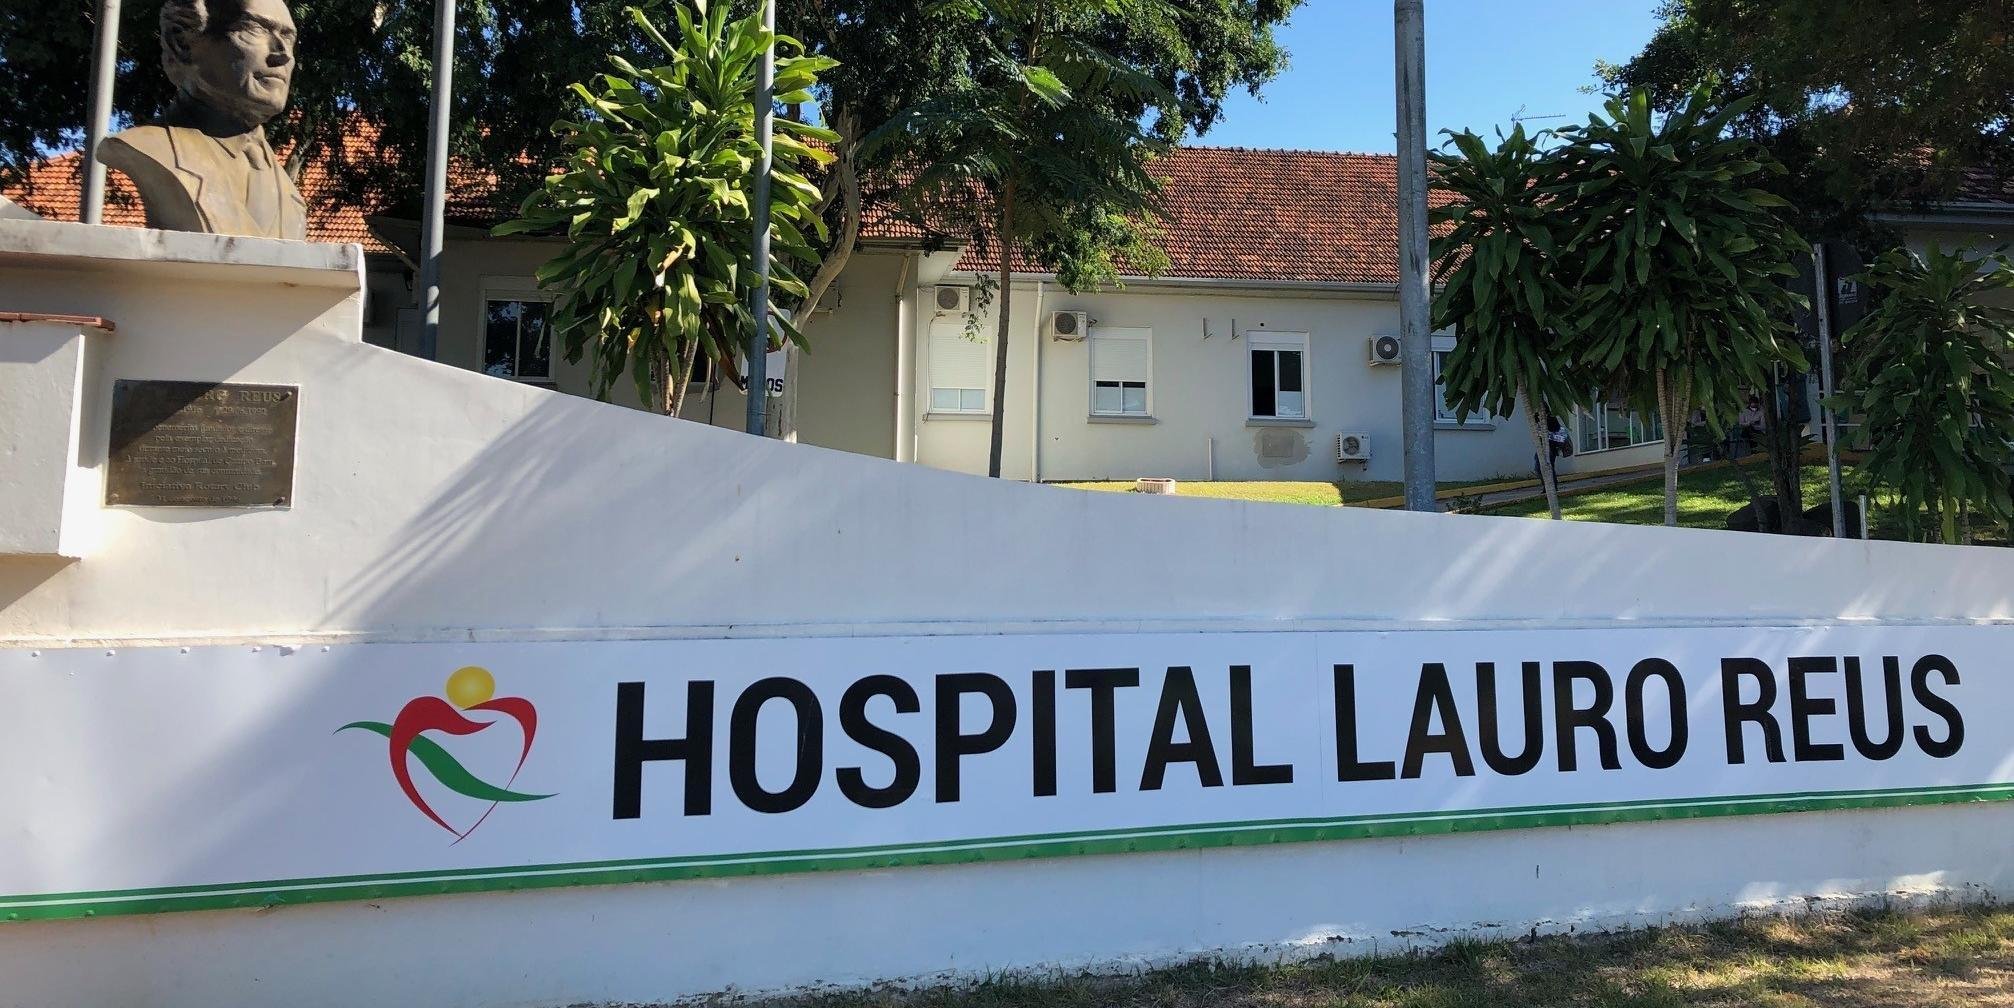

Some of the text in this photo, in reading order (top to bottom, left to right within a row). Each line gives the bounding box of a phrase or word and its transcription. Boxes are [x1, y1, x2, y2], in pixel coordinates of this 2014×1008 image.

[612, 654, 1965, 820] HOSPITAL LAURO REUS
